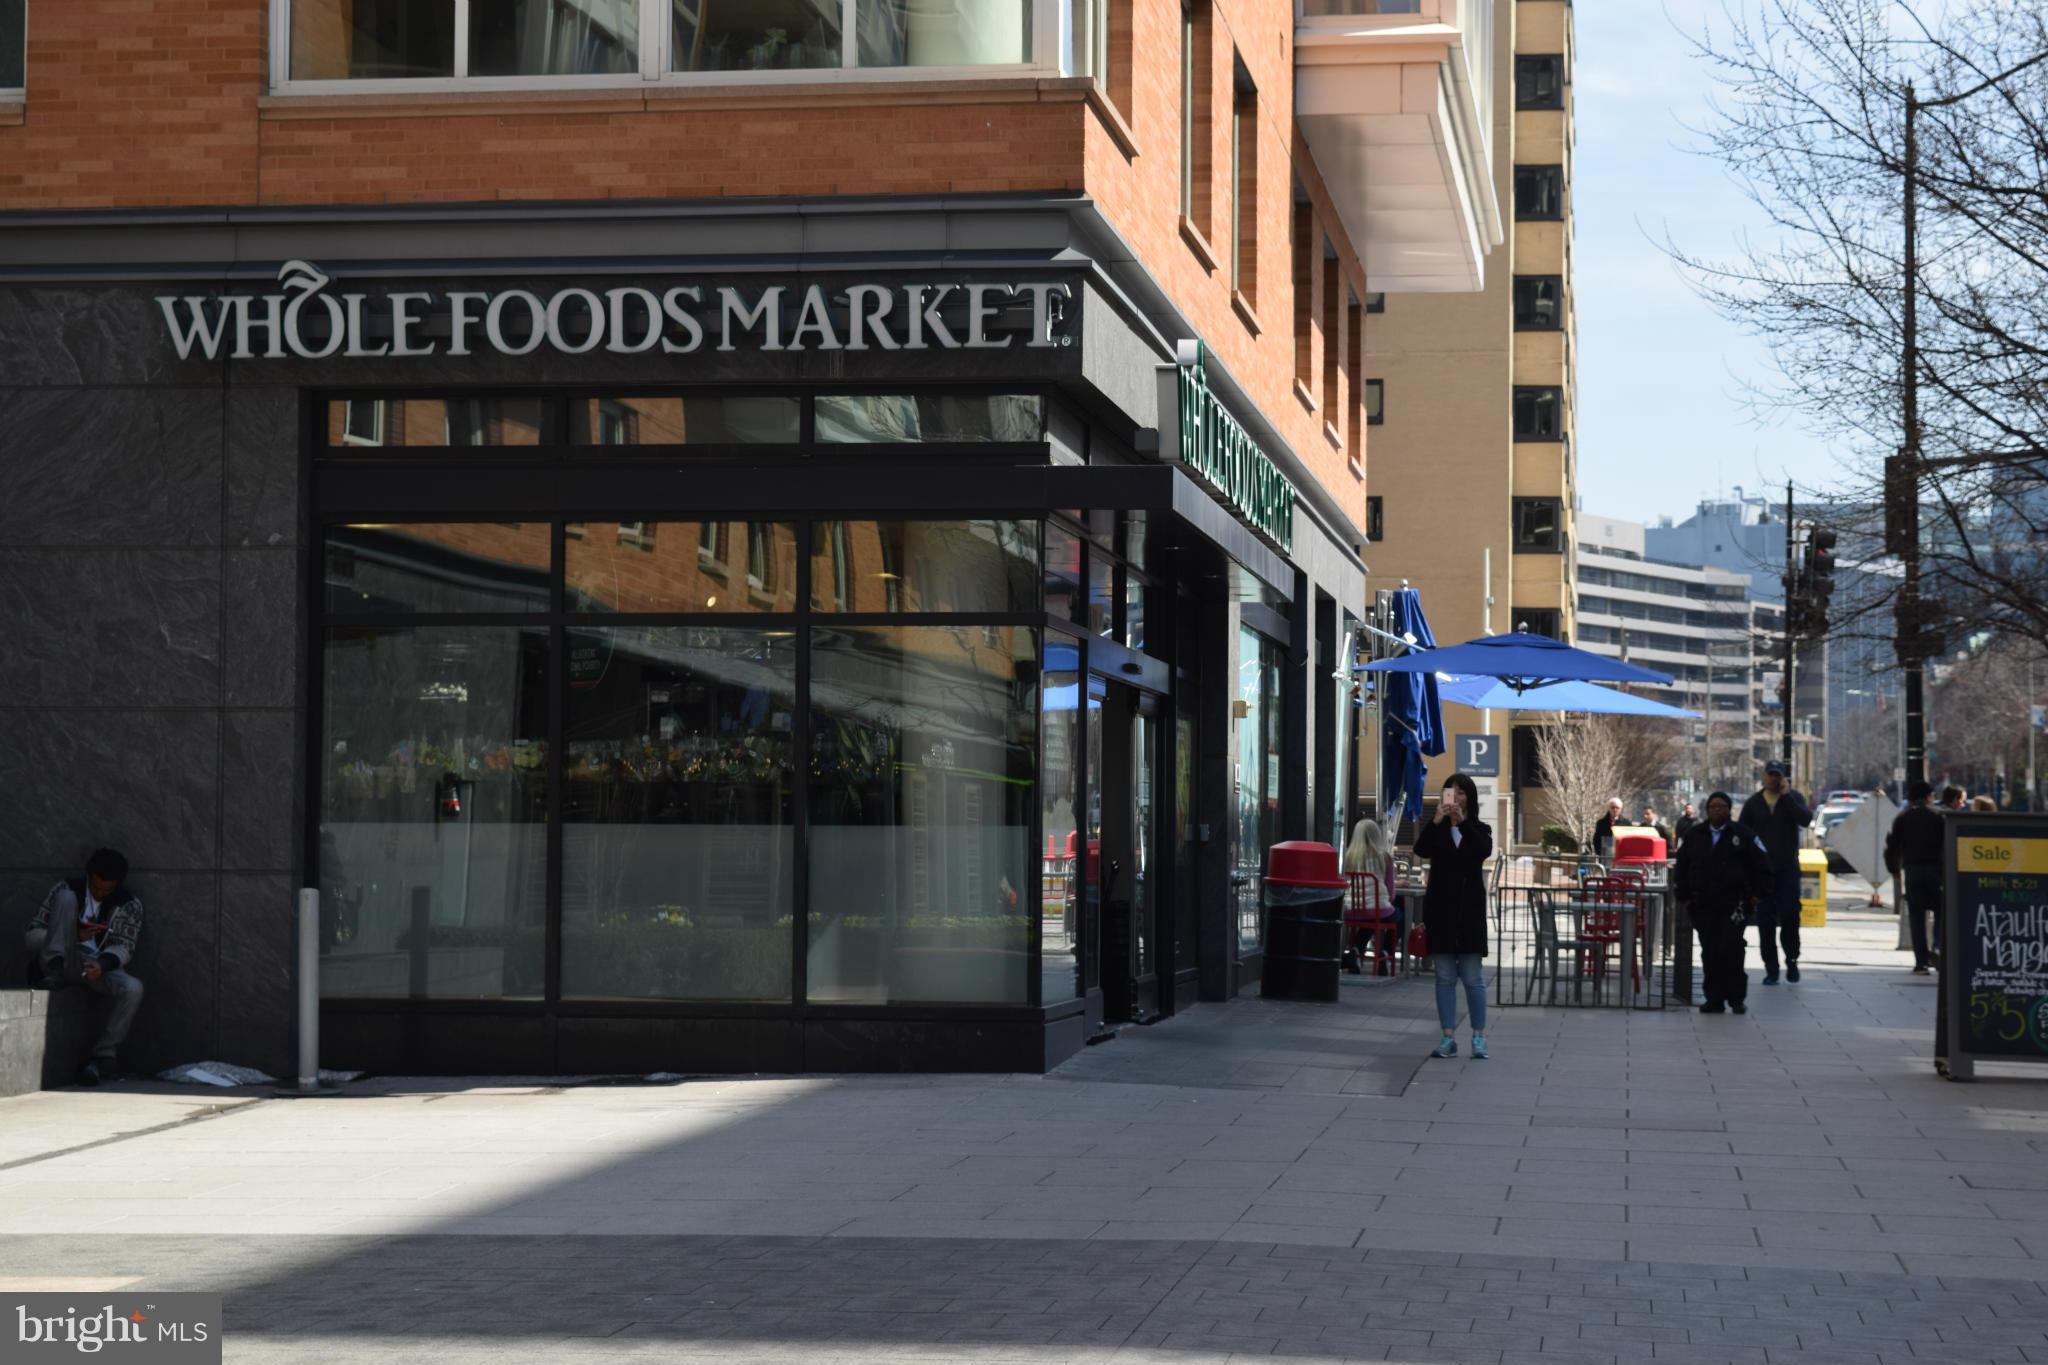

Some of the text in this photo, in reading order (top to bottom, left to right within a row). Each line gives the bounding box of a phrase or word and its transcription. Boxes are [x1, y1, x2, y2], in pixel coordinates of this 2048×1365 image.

[155, 283, 1072, 361] WHOLE FOODS MARKET
[1467, 739, 1488, 765] P
[1971, 845, 2011, 861] Sale
